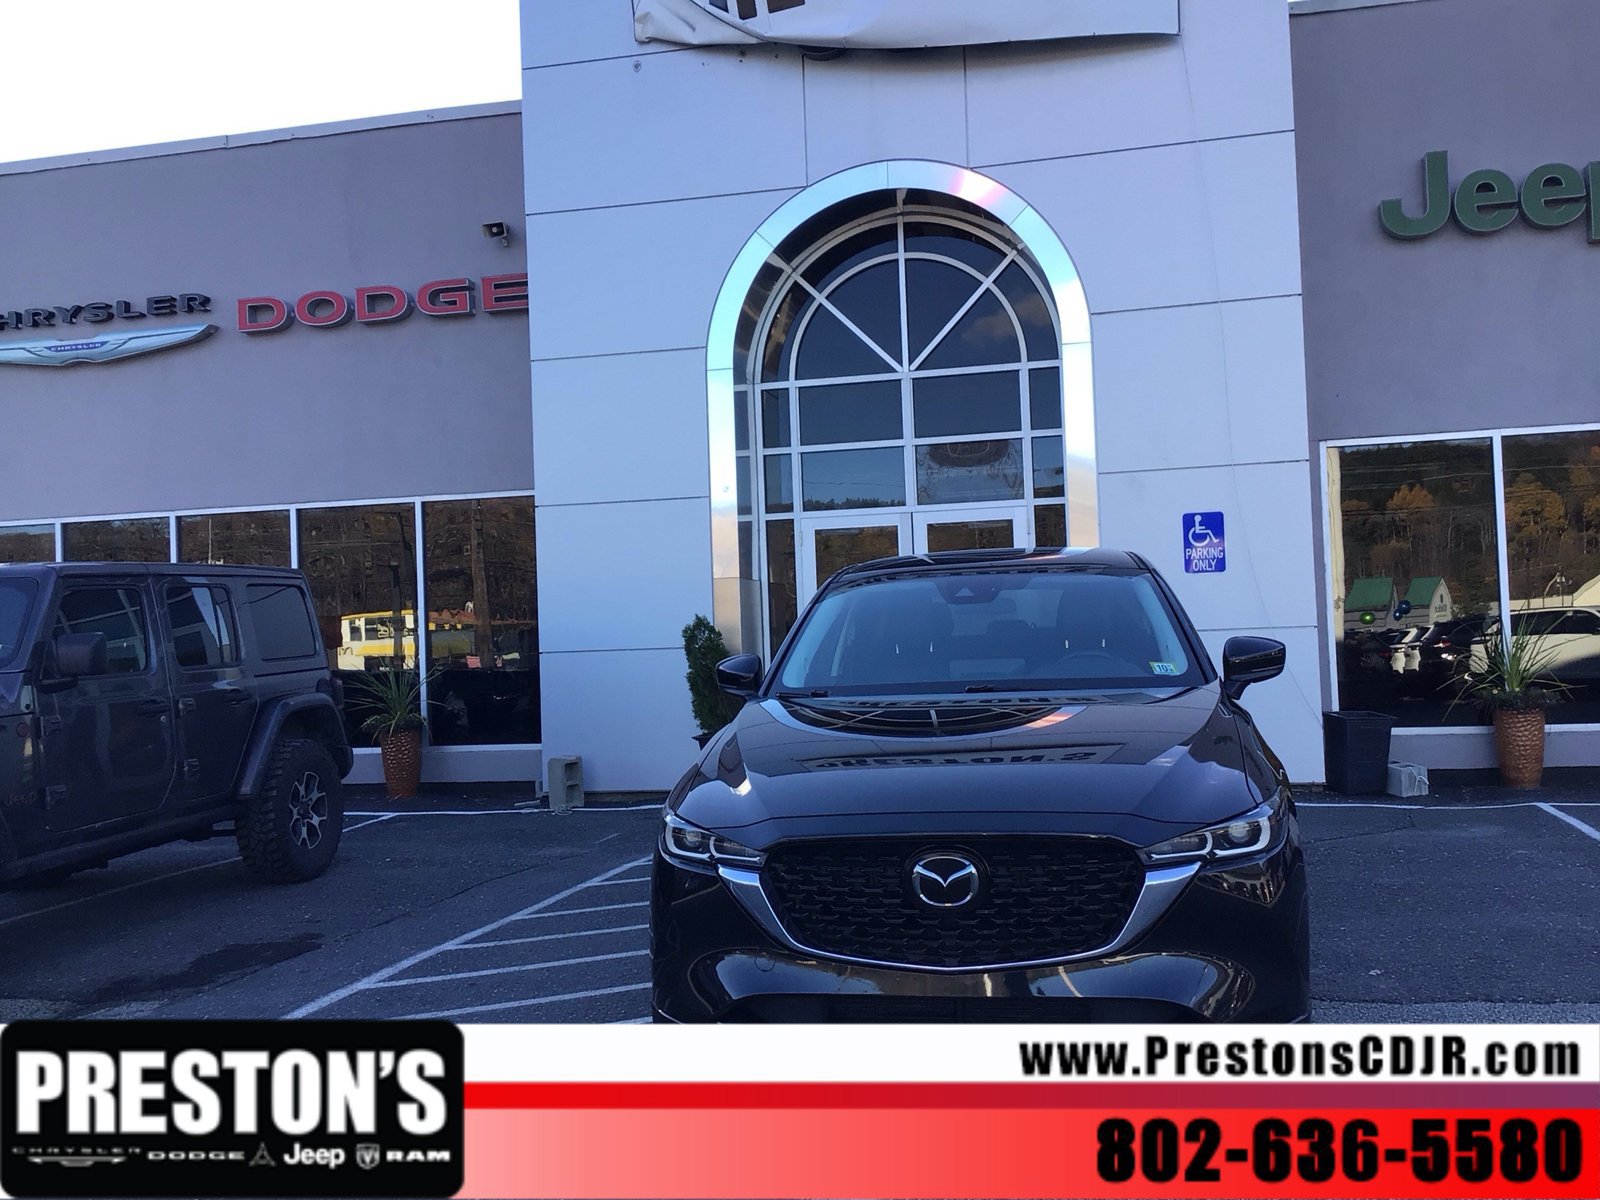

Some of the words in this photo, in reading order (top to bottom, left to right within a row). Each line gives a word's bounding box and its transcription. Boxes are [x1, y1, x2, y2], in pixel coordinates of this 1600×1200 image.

[1379, 150, 1600, 244] Jee
[237, 273, 528, 334] DODGE
[50, 342, 102, 352] CHRYSLER
[1185, 547, 1224, 560] PARKING
[1192, 558, 1217, 571] ONLY
